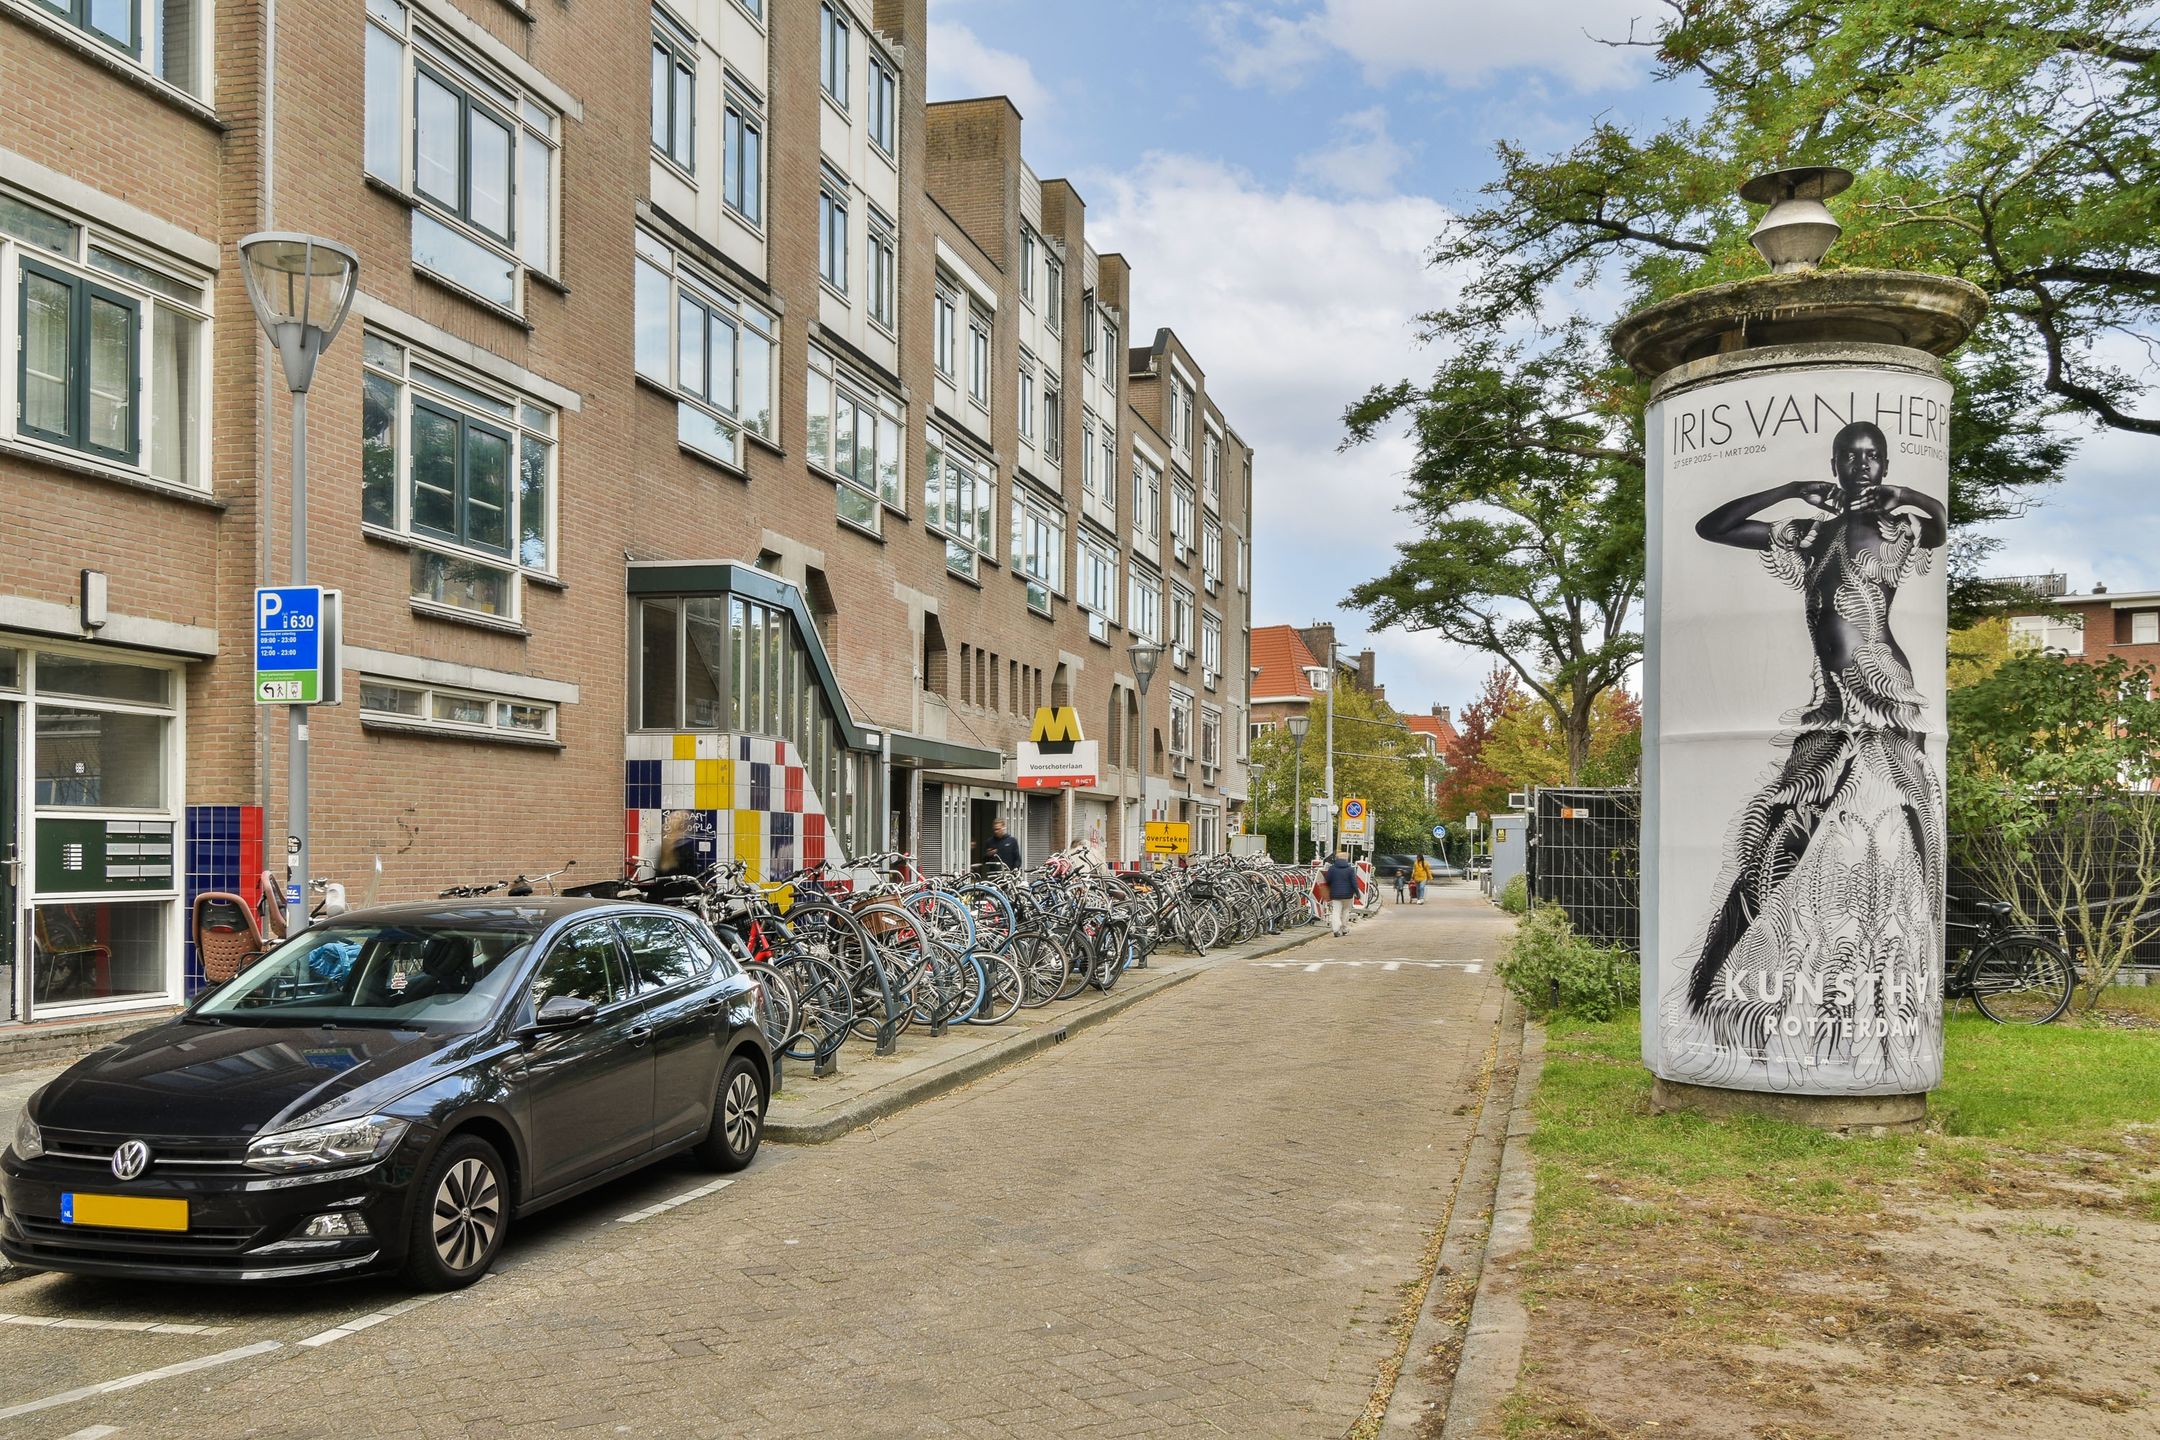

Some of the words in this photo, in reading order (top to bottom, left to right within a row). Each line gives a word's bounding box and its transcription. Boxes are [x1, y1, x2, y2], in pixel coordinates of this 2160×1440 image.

[1673, 404, 1732, 455] IRIS
[1745, 392, 1854, 438] VAN
[1681, 457, 1693, 468] SEP
[1693, 453, 1712, 464] 2025
[1724, 447, 1743, 458] MRT
[1744, 443, 1767, 455] 2026
[261, 593, 282, 629] P
[290, 615, 314, 628] 630
[1146, 835, 1188, 843] oversteken
[1764, 1015, 1920, 1038] ROTTERDAM
